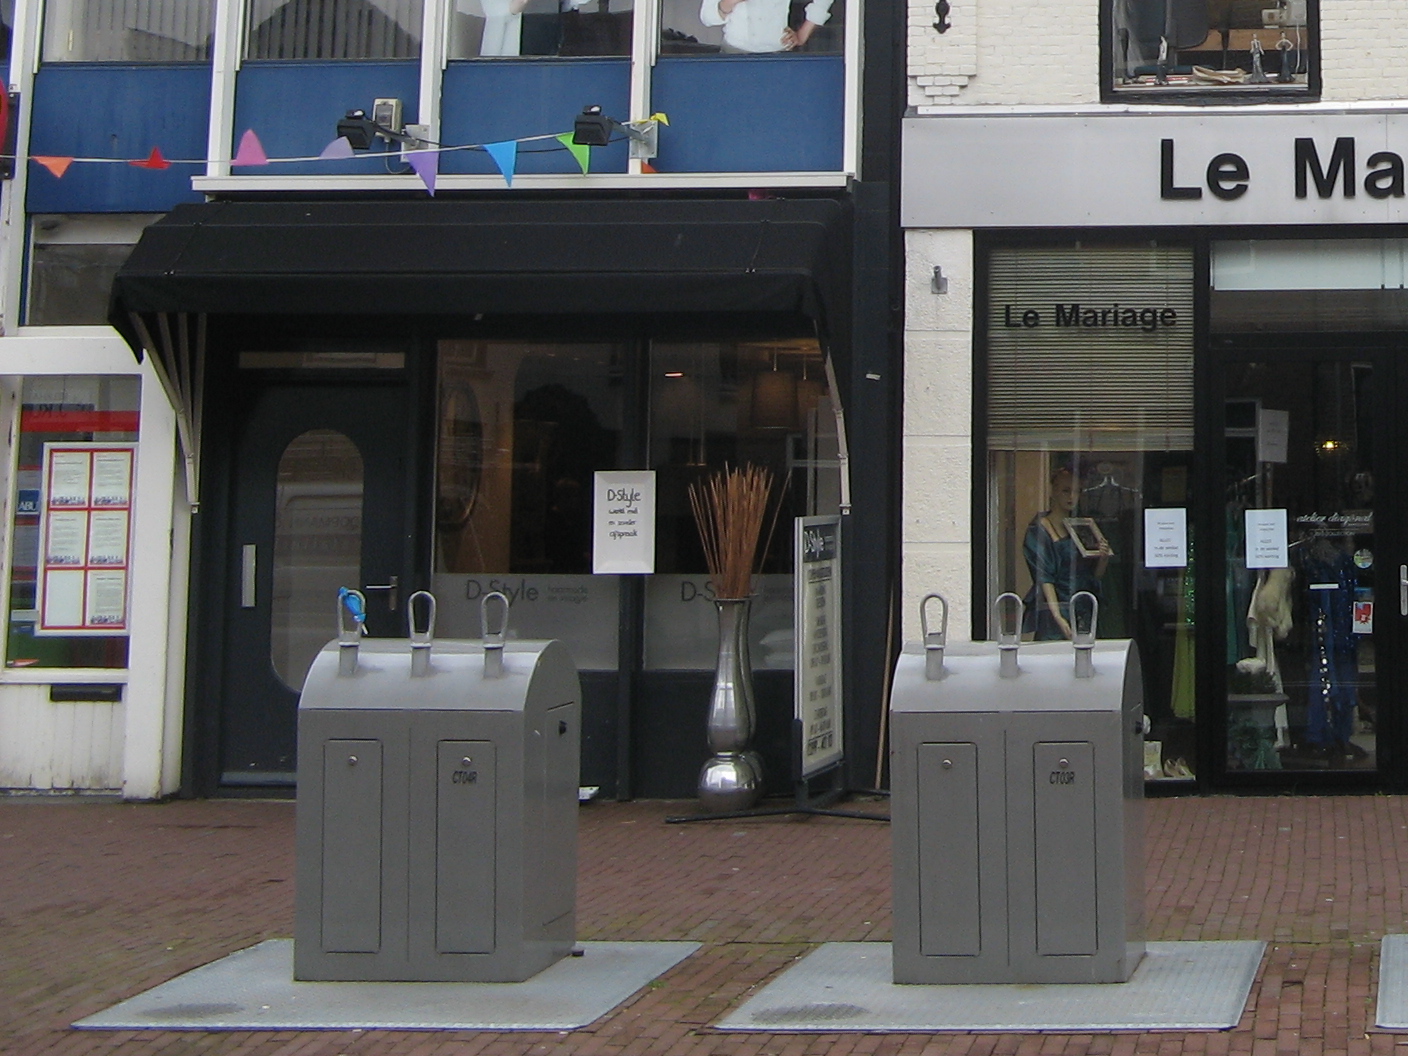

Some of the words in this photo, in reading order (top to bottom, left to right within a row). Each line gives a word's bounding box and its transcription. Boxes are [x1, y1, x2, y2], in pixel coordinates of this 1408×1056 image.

[1160, 138, 1249, 200] Le
[1004, 305, 1040, 328] Le
[1055, 303, 1177, 332] Mariage
[607, 488, 641, 508] D-Style
